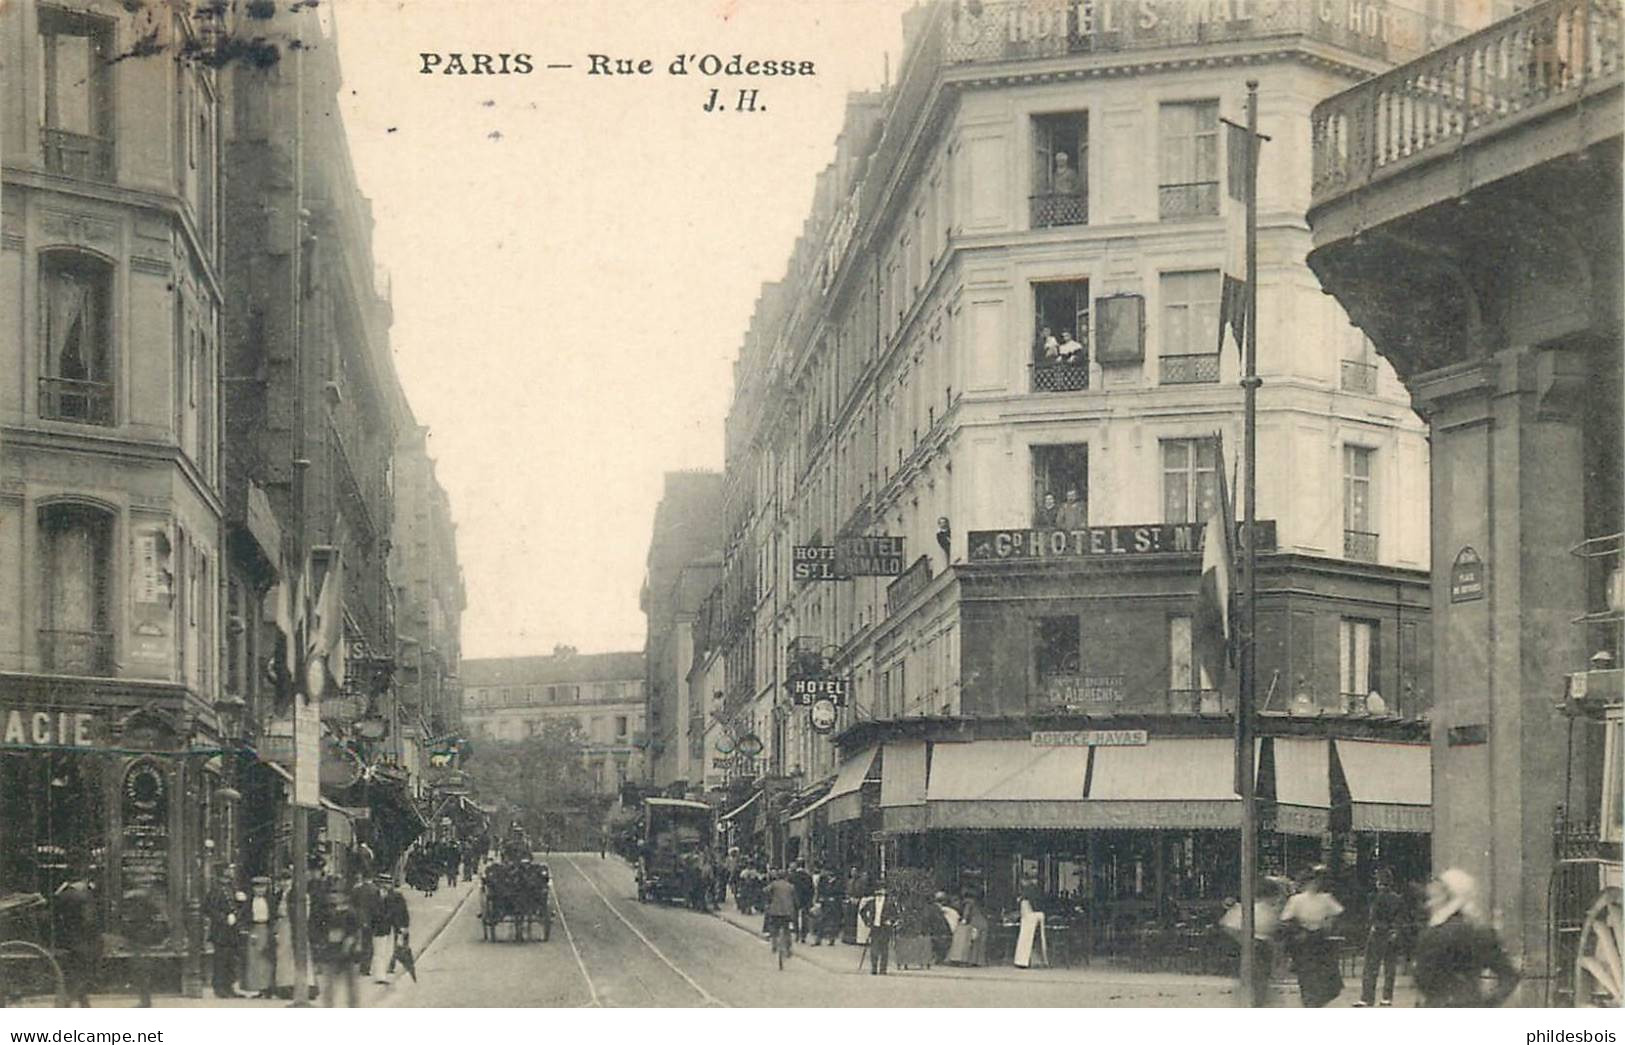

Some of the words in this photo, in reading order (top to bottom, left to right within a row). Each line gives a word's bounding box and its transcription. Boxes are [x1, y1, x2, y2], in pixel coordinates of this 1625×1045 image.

[1030, 528, 1126, 556] HOTEL
[796, 681, 844, 694] HOTEL
[4, 709, 94, 746] ACIE
[1095, 731, 1143, 744] HAVAS
